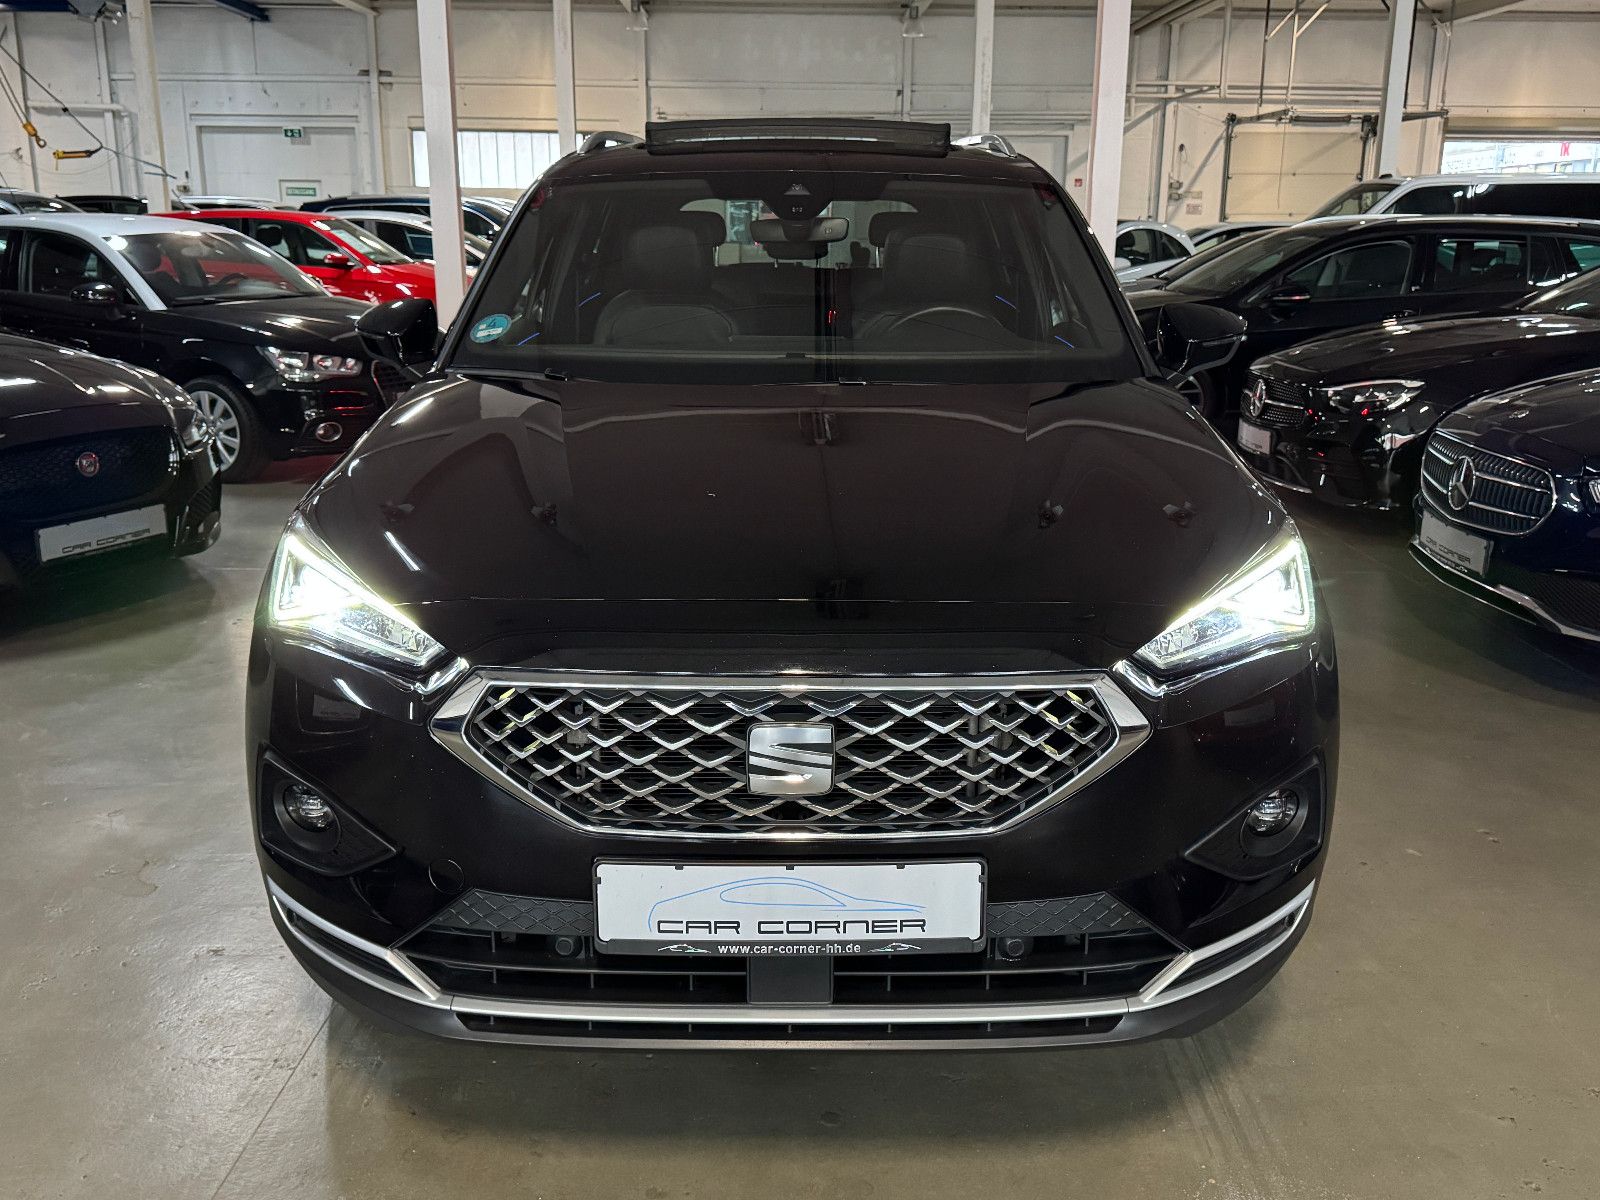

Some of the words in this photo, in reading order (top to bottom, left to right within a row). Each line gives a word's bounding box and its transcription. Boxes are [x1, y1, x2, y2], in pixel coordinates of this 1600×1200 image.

[657, 920, 741, 935] CAR
[757, 918, 927, 935] CORNER
[717, 943, 861, 954] www.car-corner-hh.de
